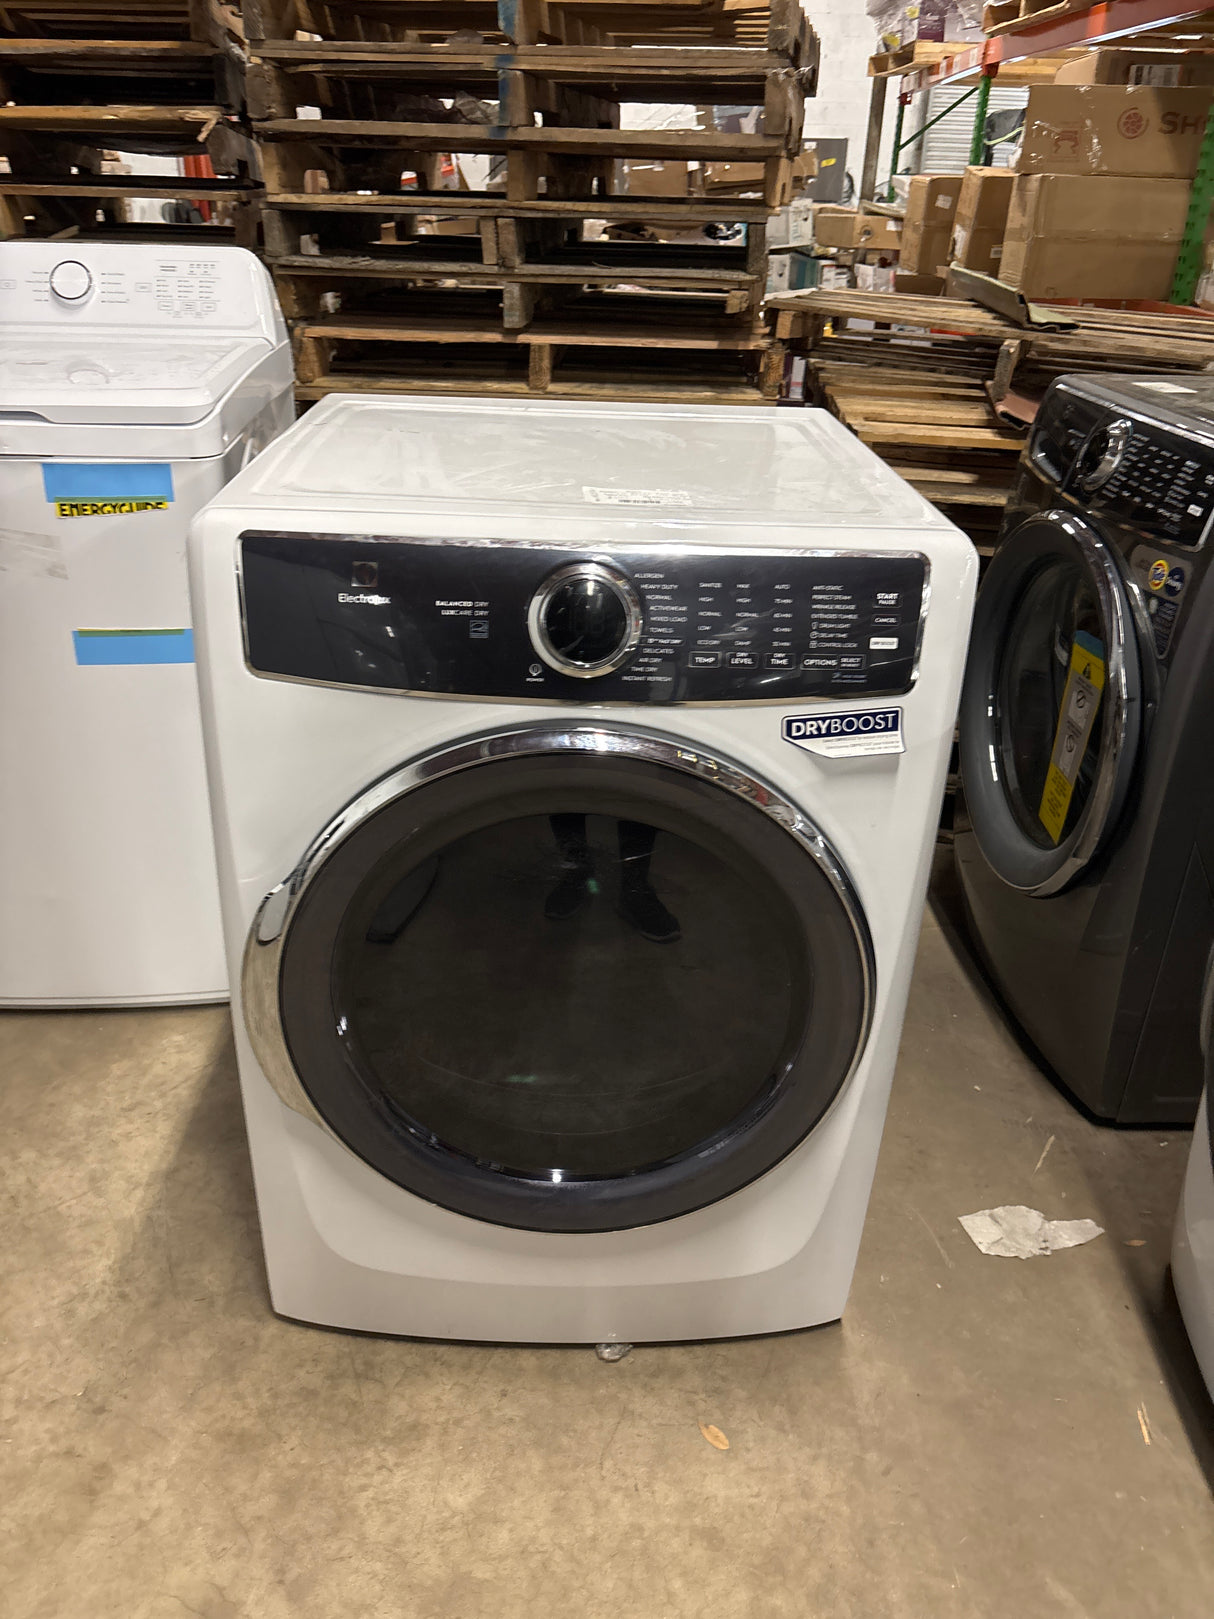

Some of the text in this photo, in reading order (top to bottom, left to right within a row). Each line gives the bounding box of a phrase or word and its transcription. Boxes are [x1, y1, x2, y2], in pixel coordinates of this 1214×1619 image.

[1159, 111, 1207, 135] SH
[876, 592, 900, 600] START
[694, 656, 716, 664] TEMP
[791, 713, 897, 737] DRYBOOST
